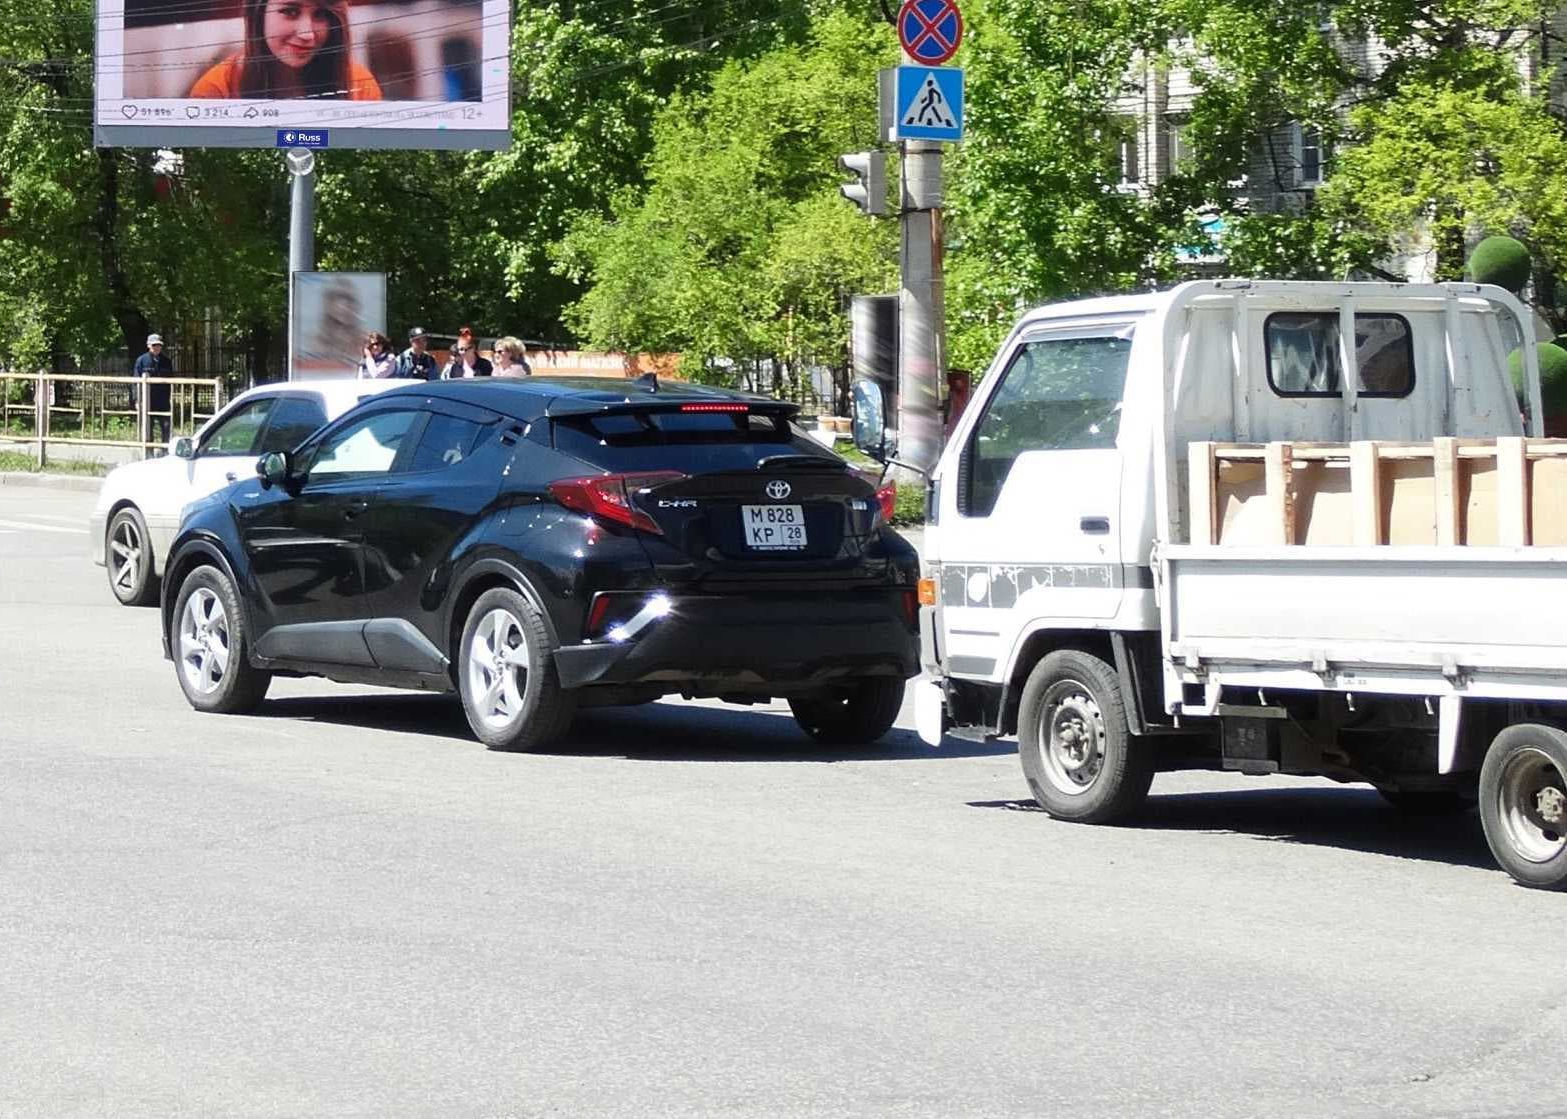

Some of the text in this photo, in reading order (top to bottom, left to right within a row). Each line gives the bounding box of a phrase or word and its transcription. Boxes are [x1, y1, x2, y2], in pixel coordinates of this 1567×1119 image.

[298, 133, 321, 142] Russ
[753, 527, 802, 543] КР 28
